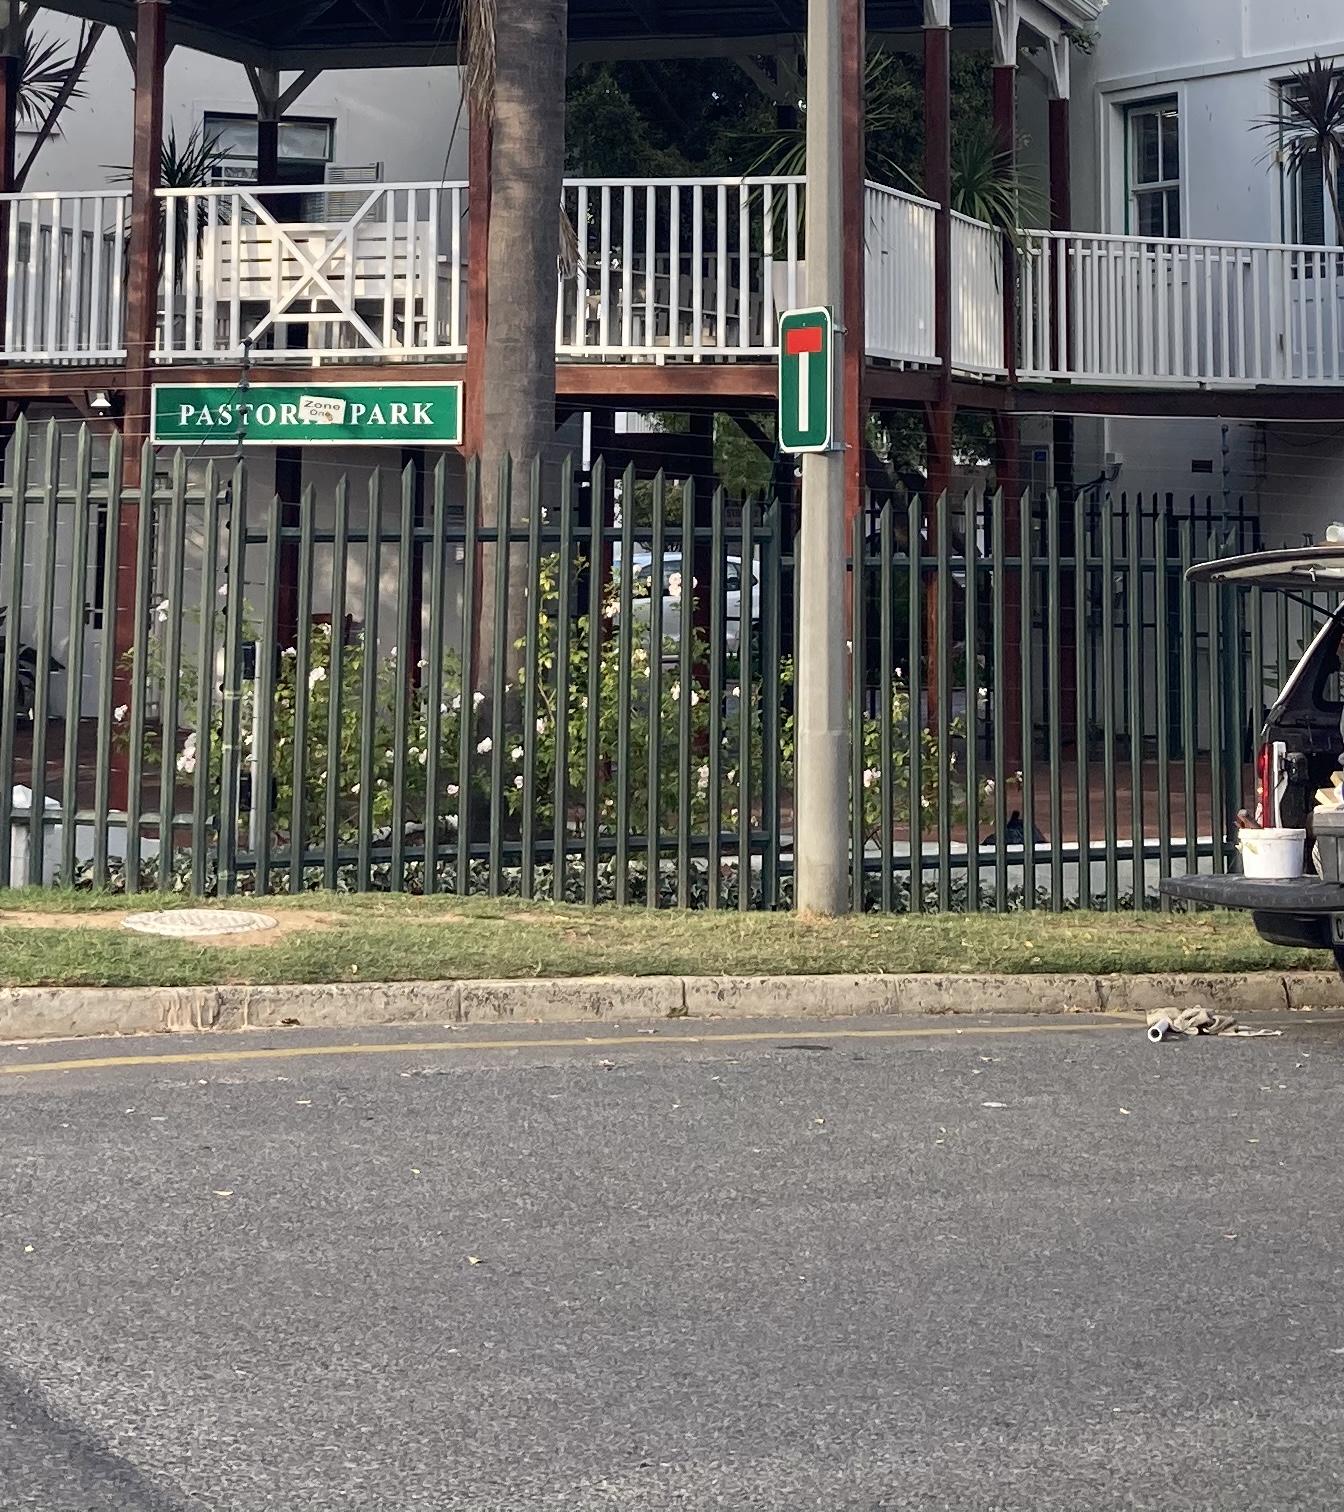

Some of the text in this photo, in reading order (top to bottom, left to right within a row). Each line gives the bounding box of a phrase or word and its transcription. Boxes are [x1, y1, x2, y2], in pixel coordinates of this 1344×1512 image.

[179, 402, 435, 426] PASTOR PARK
[303, 399, 341, 411] Zone
